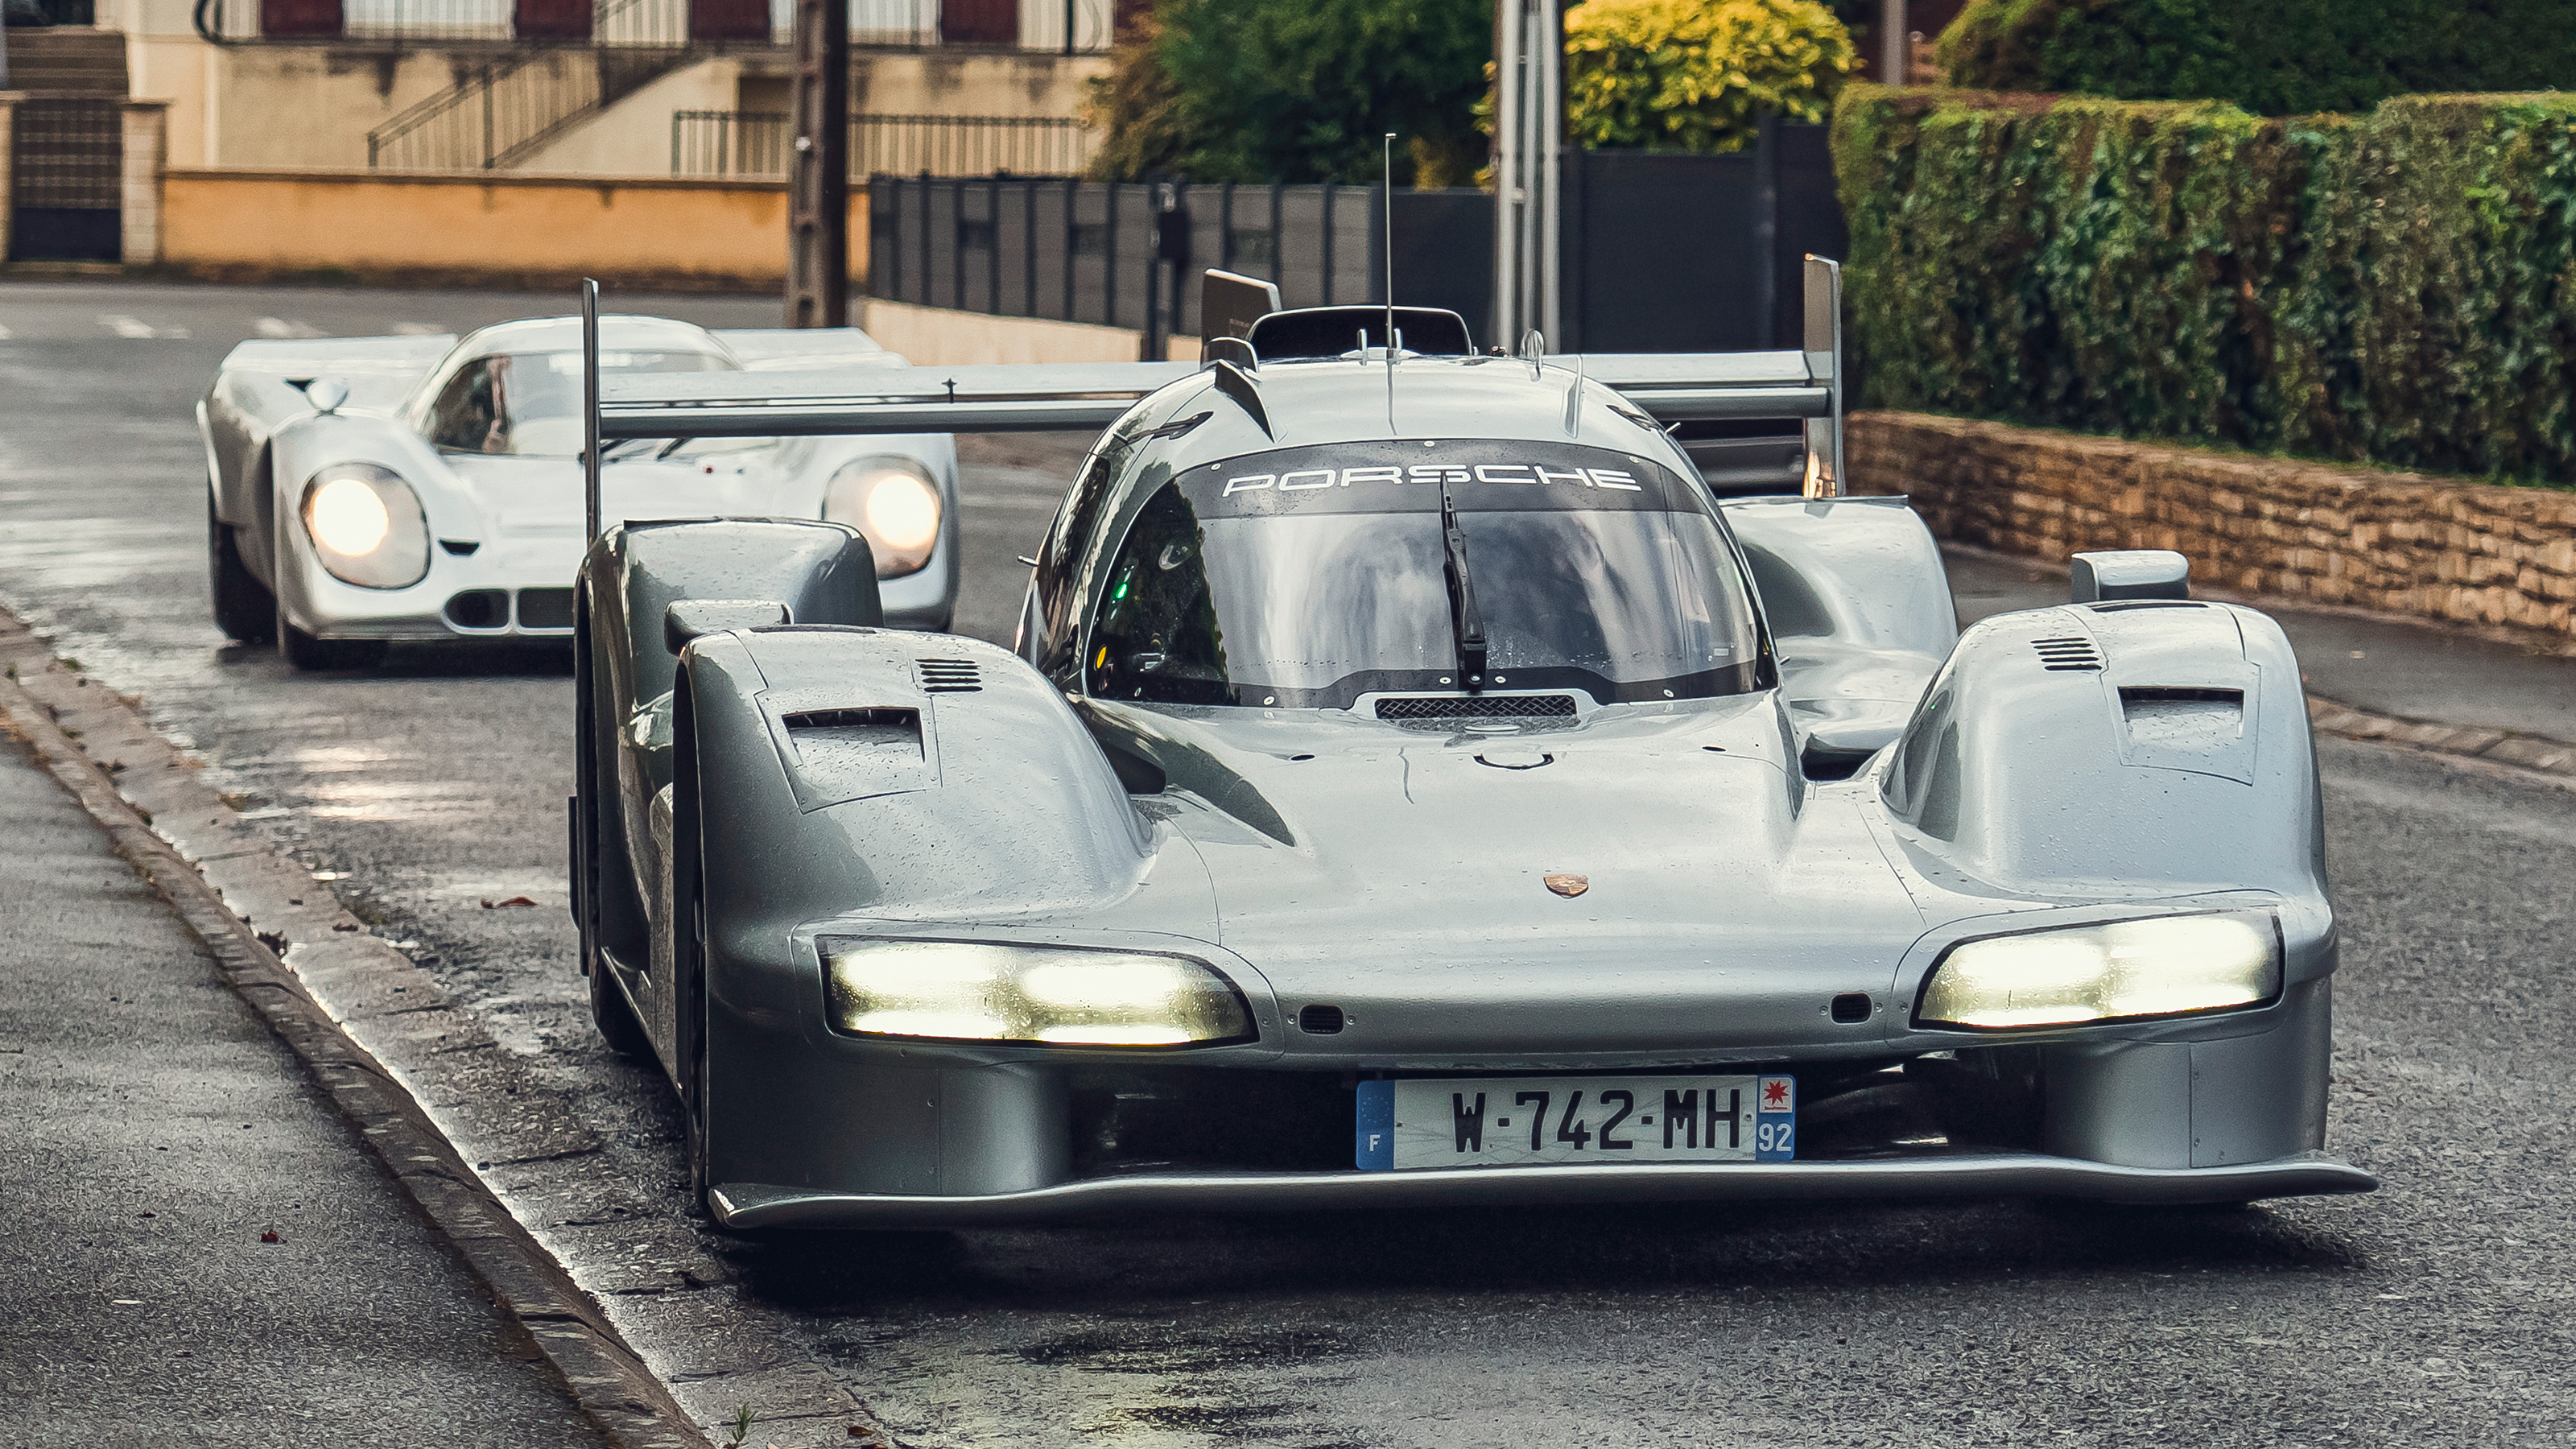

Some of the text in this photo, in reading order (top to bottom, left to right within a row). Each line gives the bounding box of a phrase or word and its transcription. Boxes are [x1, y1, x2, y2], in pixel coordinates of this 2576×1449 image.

[1222, 464, 1642, 497] PORSCHE
[1452, 1088, 1740, 1153] W-742-MH
[1369, 1134, 1381, 1152] F
[1758, 1123, 1792, 1151] 92
